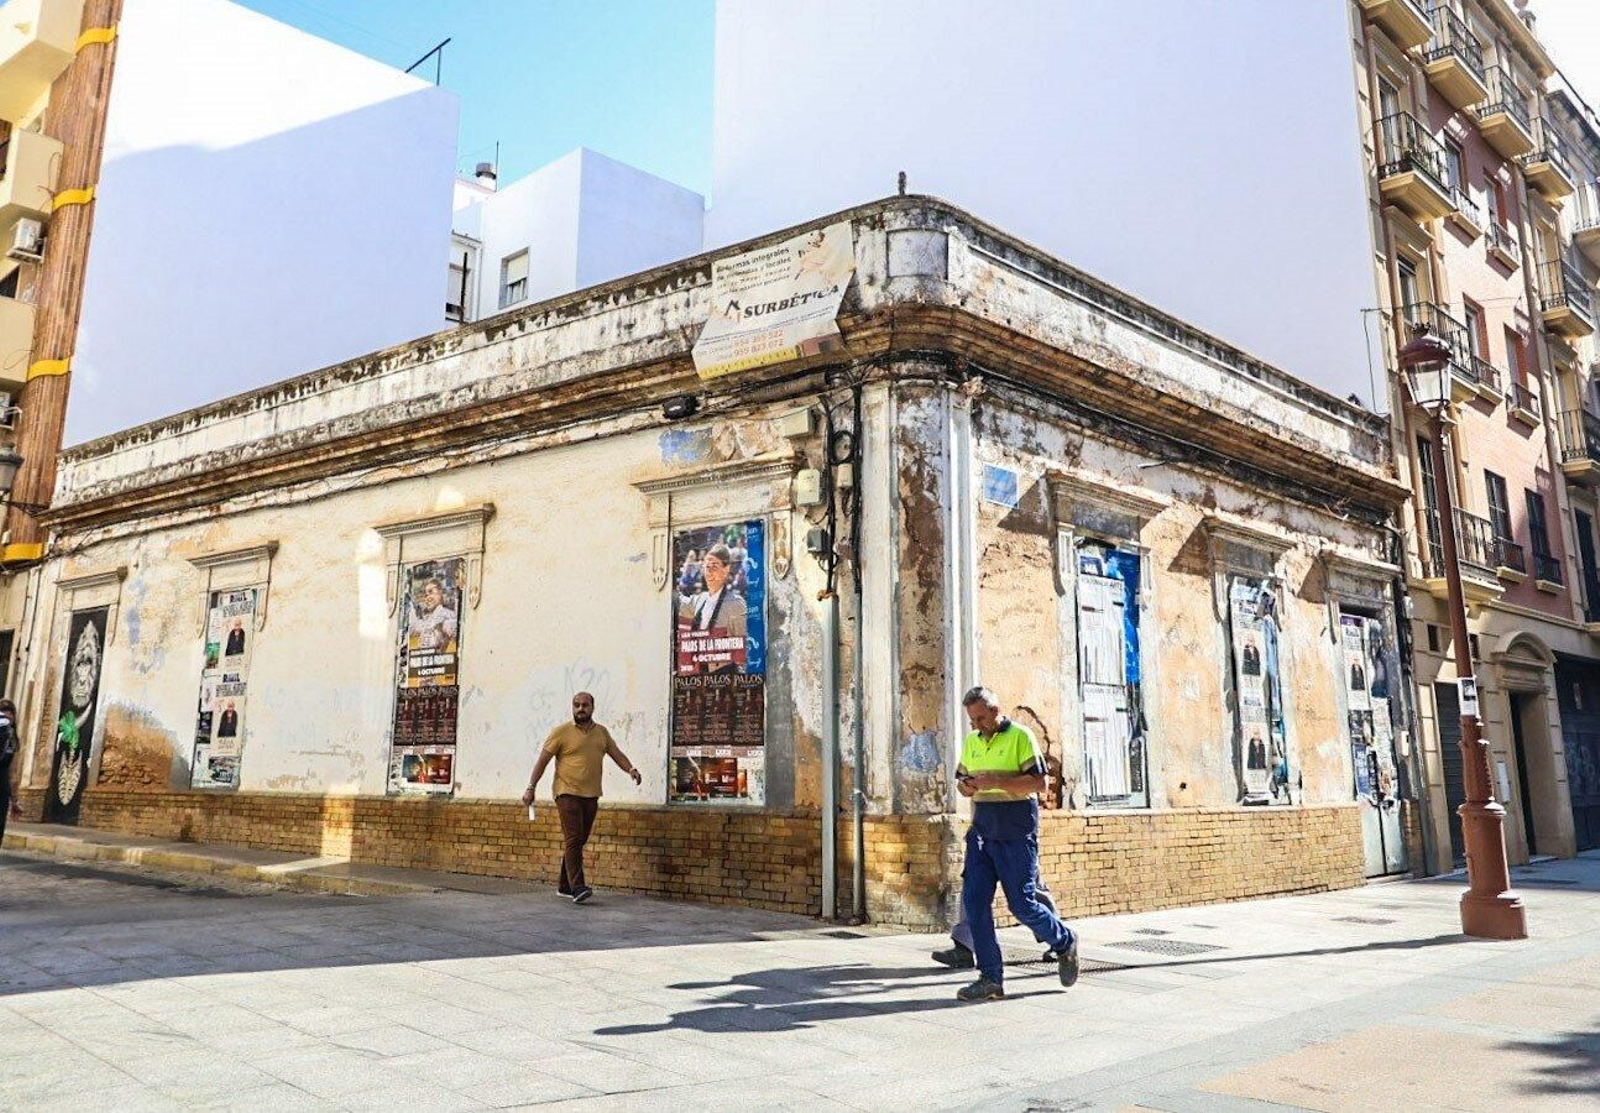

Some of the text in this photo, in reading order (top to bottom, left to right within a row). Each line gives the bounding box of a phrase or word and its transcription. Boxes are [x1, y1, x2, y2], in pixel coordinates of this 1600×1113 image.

[752, 247, 790, 264] integrales
[681, 637, 744, 652] PALOS DE LA FRONTERA
[698, 653, 732, 662] OCTUBRE
[674, 674, 763, 687] PALOS PALOS PALOS
